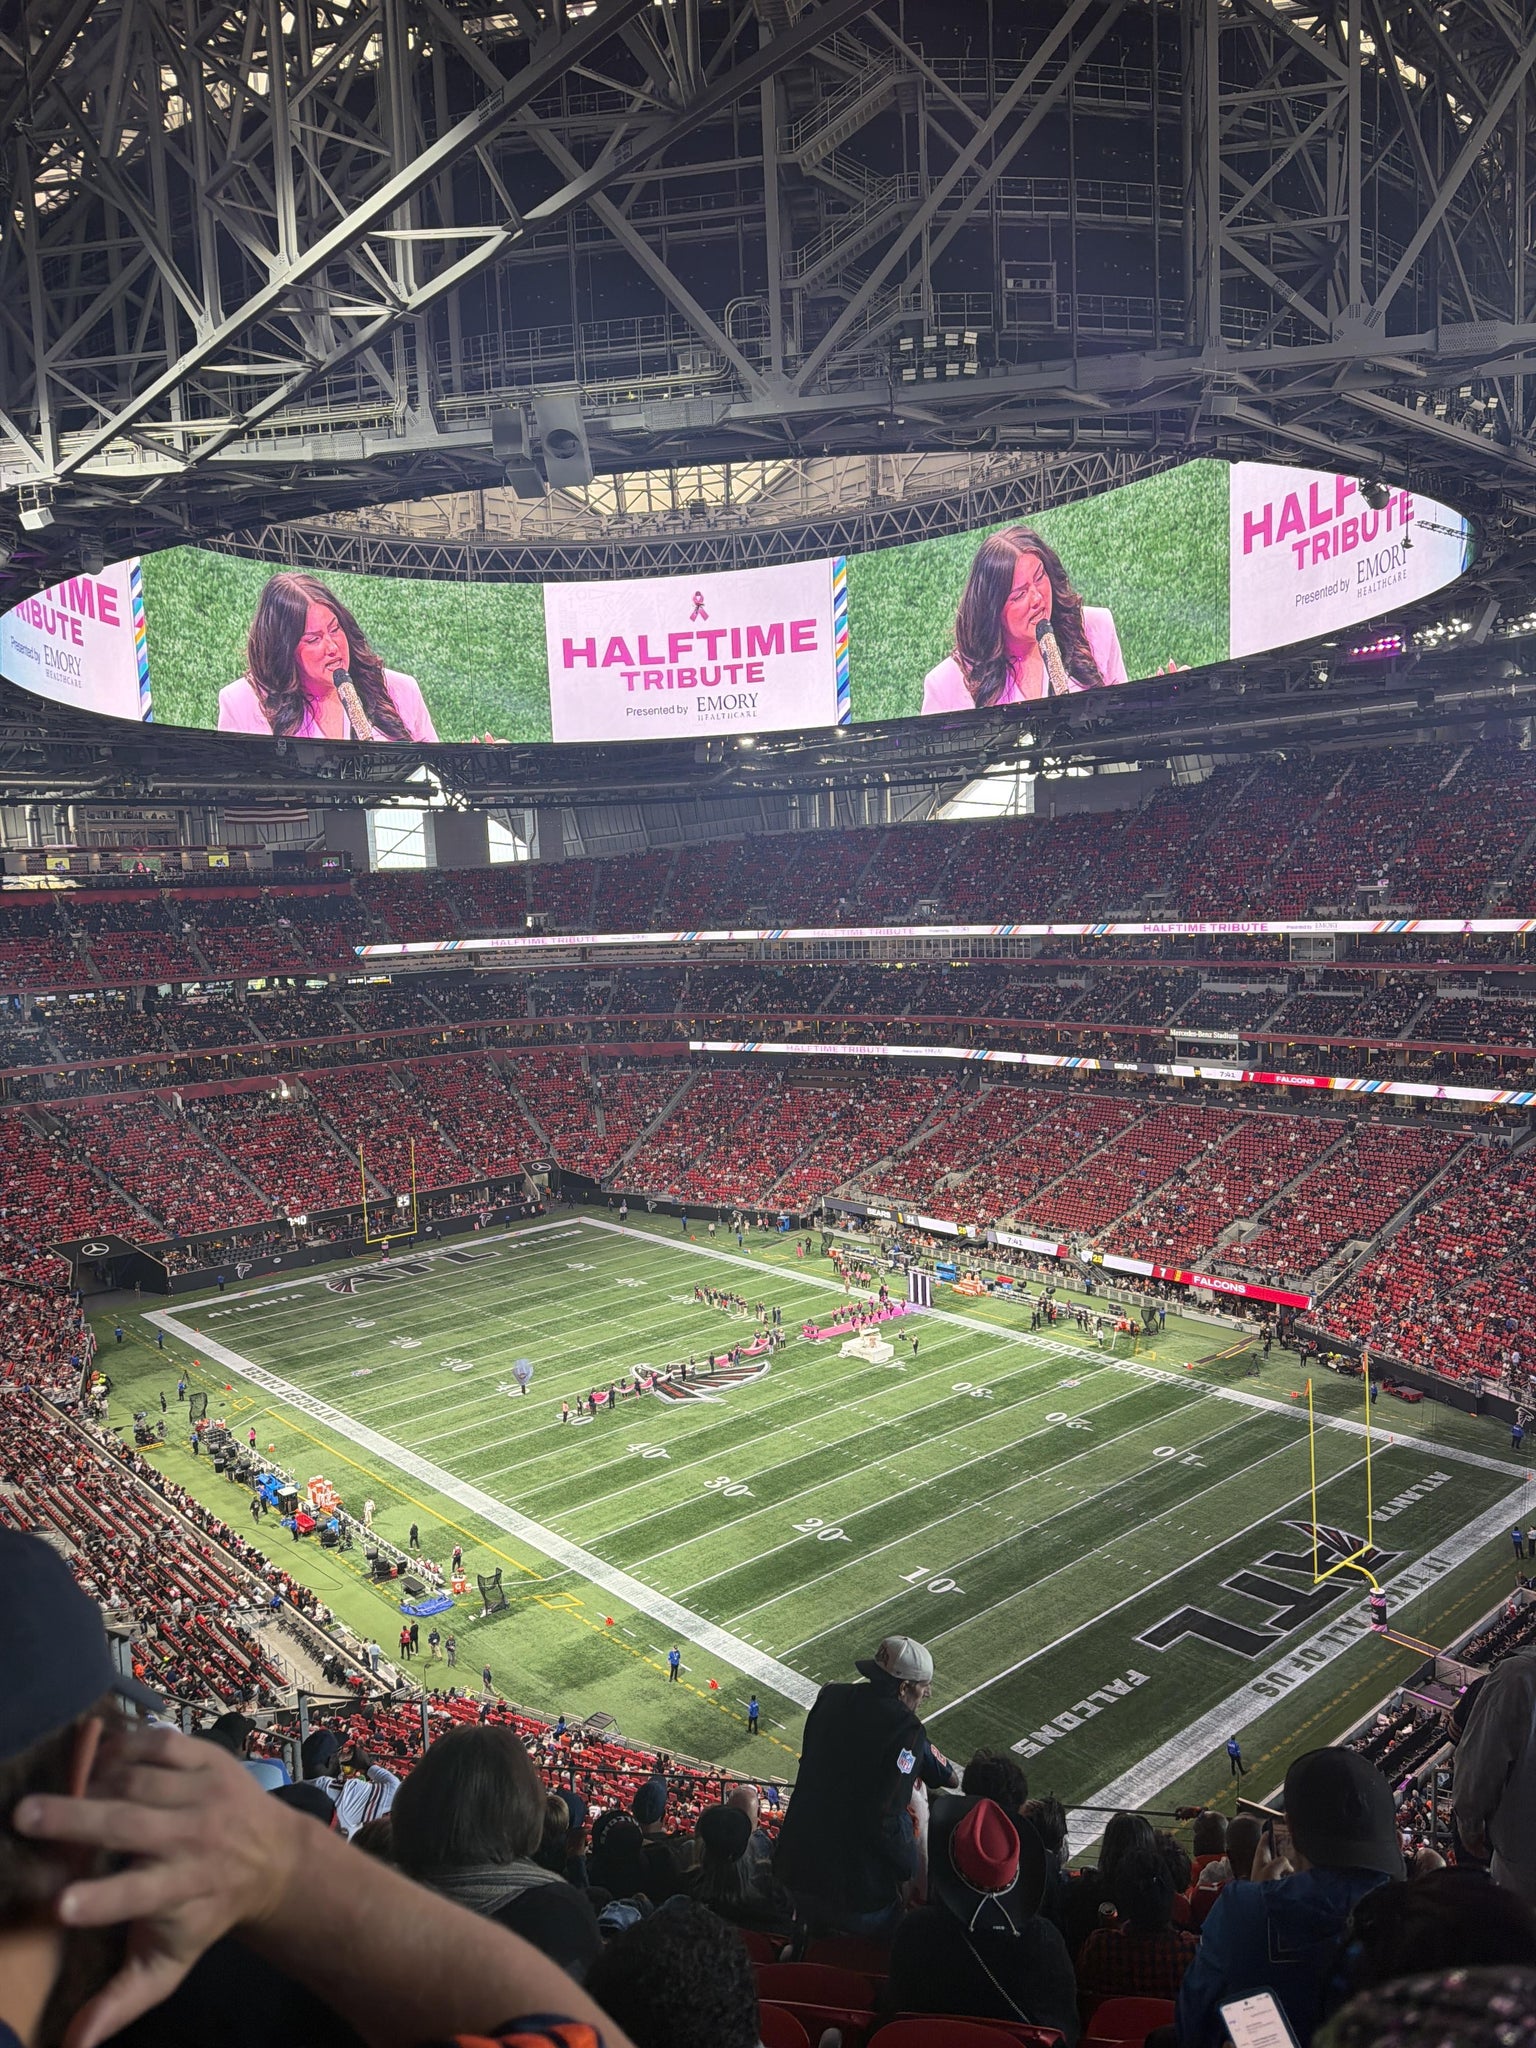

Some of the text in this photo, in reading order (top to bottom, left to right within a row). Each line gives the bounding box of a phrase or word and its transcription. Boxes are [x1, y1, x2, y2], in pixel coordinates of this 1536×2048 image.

[1292, 490, 1415, 570] TRIBUTE
[1357, 542, 1408, 584] EMORY
[1295, 577, 1350, 607] Presented by
[1357, 569, 1408, 598] HEALTHCARE
[15, 598, 84, 647] RIBUTE
[10, 635, 41, 665] Presented by
[562, 618, 818, 668] HALFTIME
[43, 644, 82, 677] EMORY
[45, 668, 82, 689] HEALTHCARE
[620, 661, 765, 691] TRIBUTE
[626, 703, 688, 717] Presented by
[696, 692, 759, 712] EMORY
[697, 710, 758, 722] HEALTHCARE
[1143, 923, 1207, 933] HALFTIME
[1210, 922, 1269, 932] TRIBUTE
[1170, 1028, 1212, 1038] Mercedes-Benz
[1213, 1030, 1239, 1040] Stadium
[1114, 1062, 1138, 1071] BEARS
[1275, 1075, 1315, 1086] FALCONS
[866, 1206, 891, 1219] BEARS
[1007, 1236, 1024, 1247] 7:41
[1192, 1274, 1246, 1294] FALCONS
[207, 1293, 305, 1319] ATLANTA
[344, 1316, 376, 1329] 10
[389, 1335, 422, 1349] 20
[440, 1357, 474, 1372] 30
[1027, 1337, 1221, 1393] INTERCEPT CANCER
[240, 1366, 343, 1422] INTERCEPT CANCER
[1045, 1412, 1092, 1430] 20
[626, 1442, 667, 1459] 40
[1152, 1446, 1204, 1466] 10
[703, 1476, 749, 1497] 30
[1366, 1470, 1454, 1522] ATLANTA
[792, 1517, 844, 1542] 20
[898, 1565, 957, 1594] 10
[1133, 1520, 1408, 1661] ATL
[1316, 1615, 1371, 1648] ALL
[1289, 1648, 1328, 1673] OF
[1252, 1671, 1296, 1698] US
[1010, 1669, 1151, 1759] FALCONS
